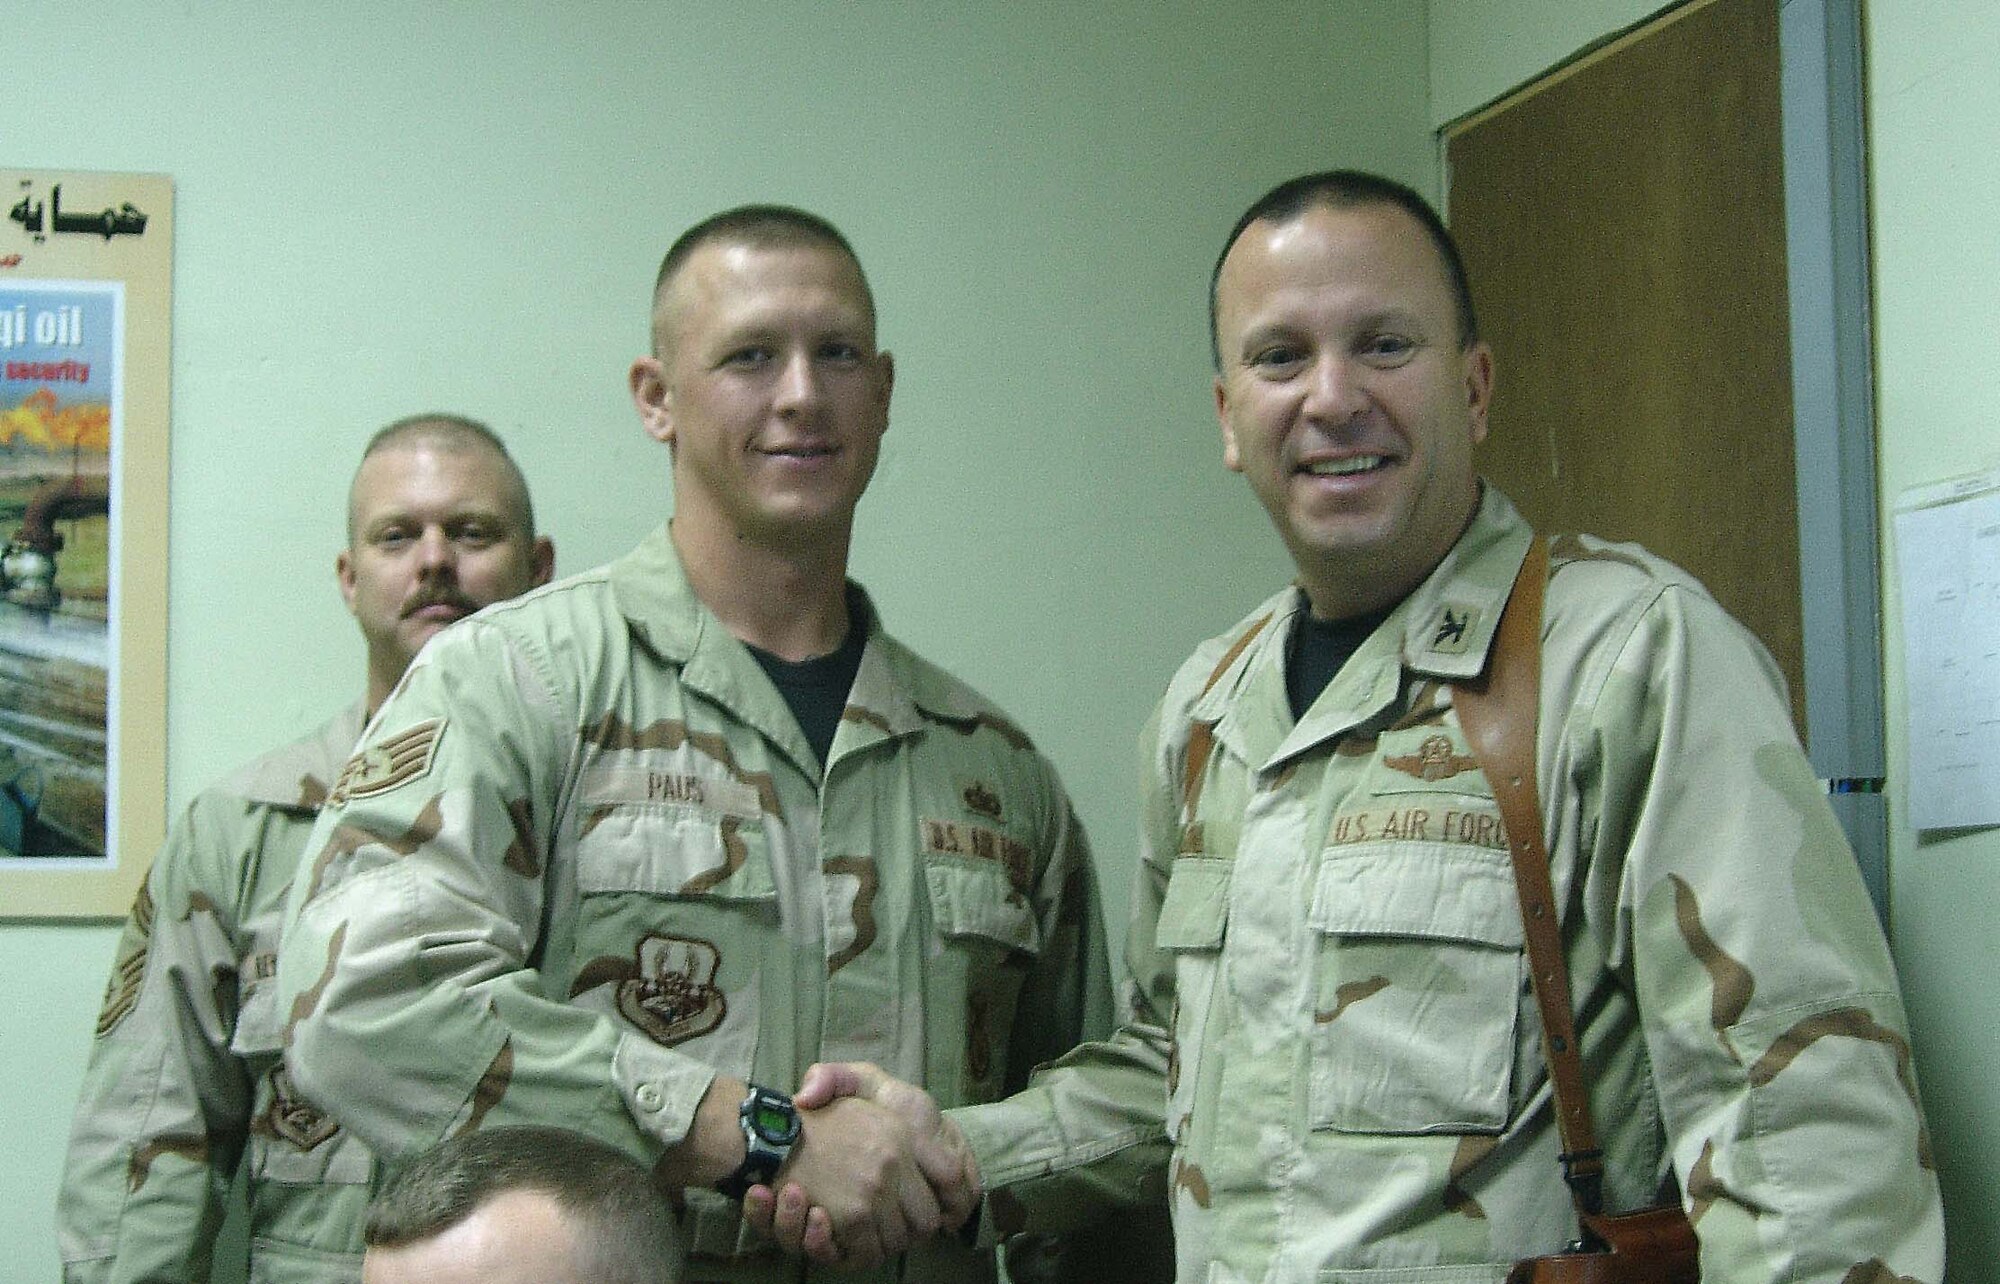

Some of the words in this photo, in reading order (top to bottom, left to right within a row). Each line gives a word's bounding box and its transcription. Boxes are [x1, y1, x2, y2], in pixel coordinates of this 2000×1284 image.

[34, 305, 83, 346] oil
[6, 361, 90, 383] security
[1381, 809, 1429, 841] AIR
